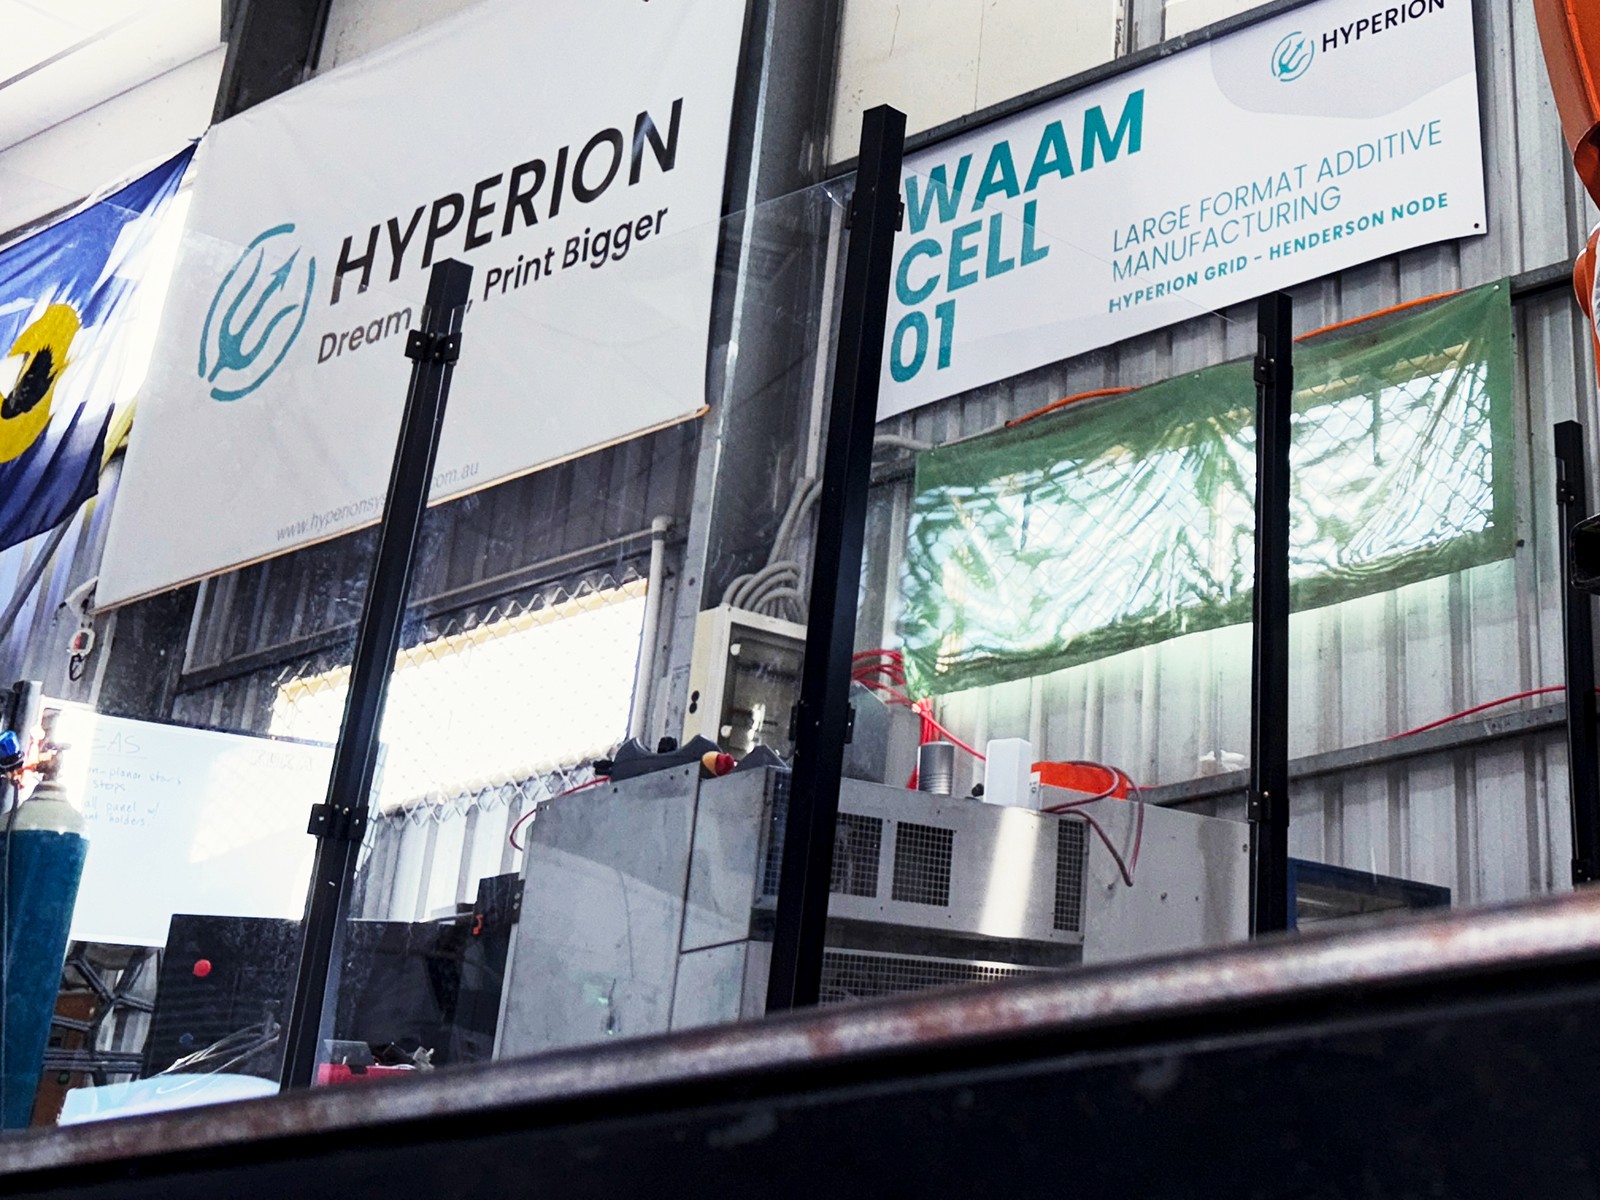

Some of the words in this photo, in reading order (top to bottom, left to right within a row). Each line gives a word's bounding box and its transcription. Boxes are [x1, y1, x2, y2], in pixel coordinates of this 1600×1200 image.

[330, 97, 684, 306] HYPERION
[905, 88, 1146, 236] WAAM
[1113, 204, 1191, 252] LARGE
[1200, 164, 1308, 222] FORMAT
[1317, 119, 1443, 182] ADDITIVE
[317, 307, 412, 364] Dream
[483, 246, 555, 302] Print
[561, 207, 669, 270] Bigger
[895, 199, 1050, 306] CELL
[1109, 271, 1199, 313] HYPERION
[1205, 255, 1248, 281] GRID
[1269, 209, 1385, 261] HENDERSON
[1391, 193, 1449, 221] NODE
[1112, 185, 1342, 282] MANUFACTURING
[890, 298, 956, 384] 01
